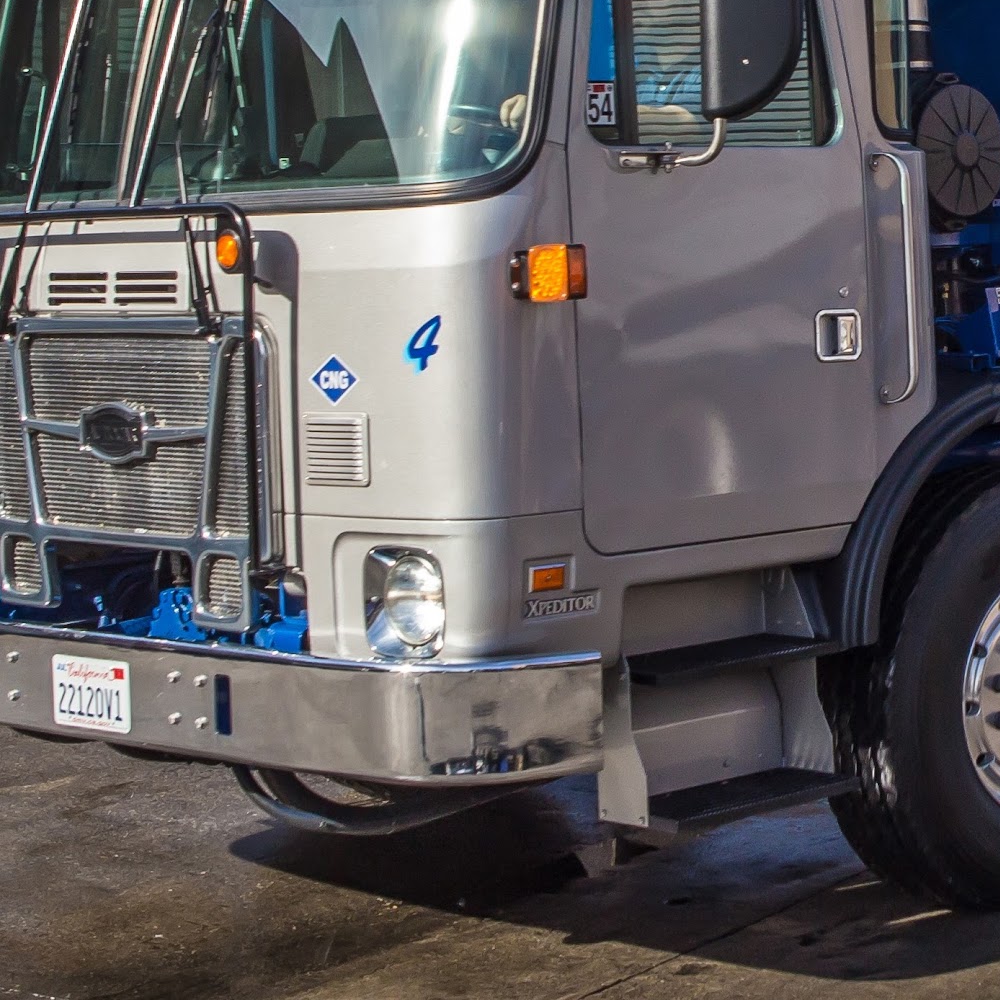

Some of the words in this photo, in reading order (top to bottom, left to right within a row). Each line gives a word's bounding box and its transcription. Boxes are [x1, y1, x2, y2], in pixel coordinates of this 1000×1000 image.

[588, 93, 613, 123] 54
[403, 314, 442, 376] 4
[320, 370, 350, 390] CNG
